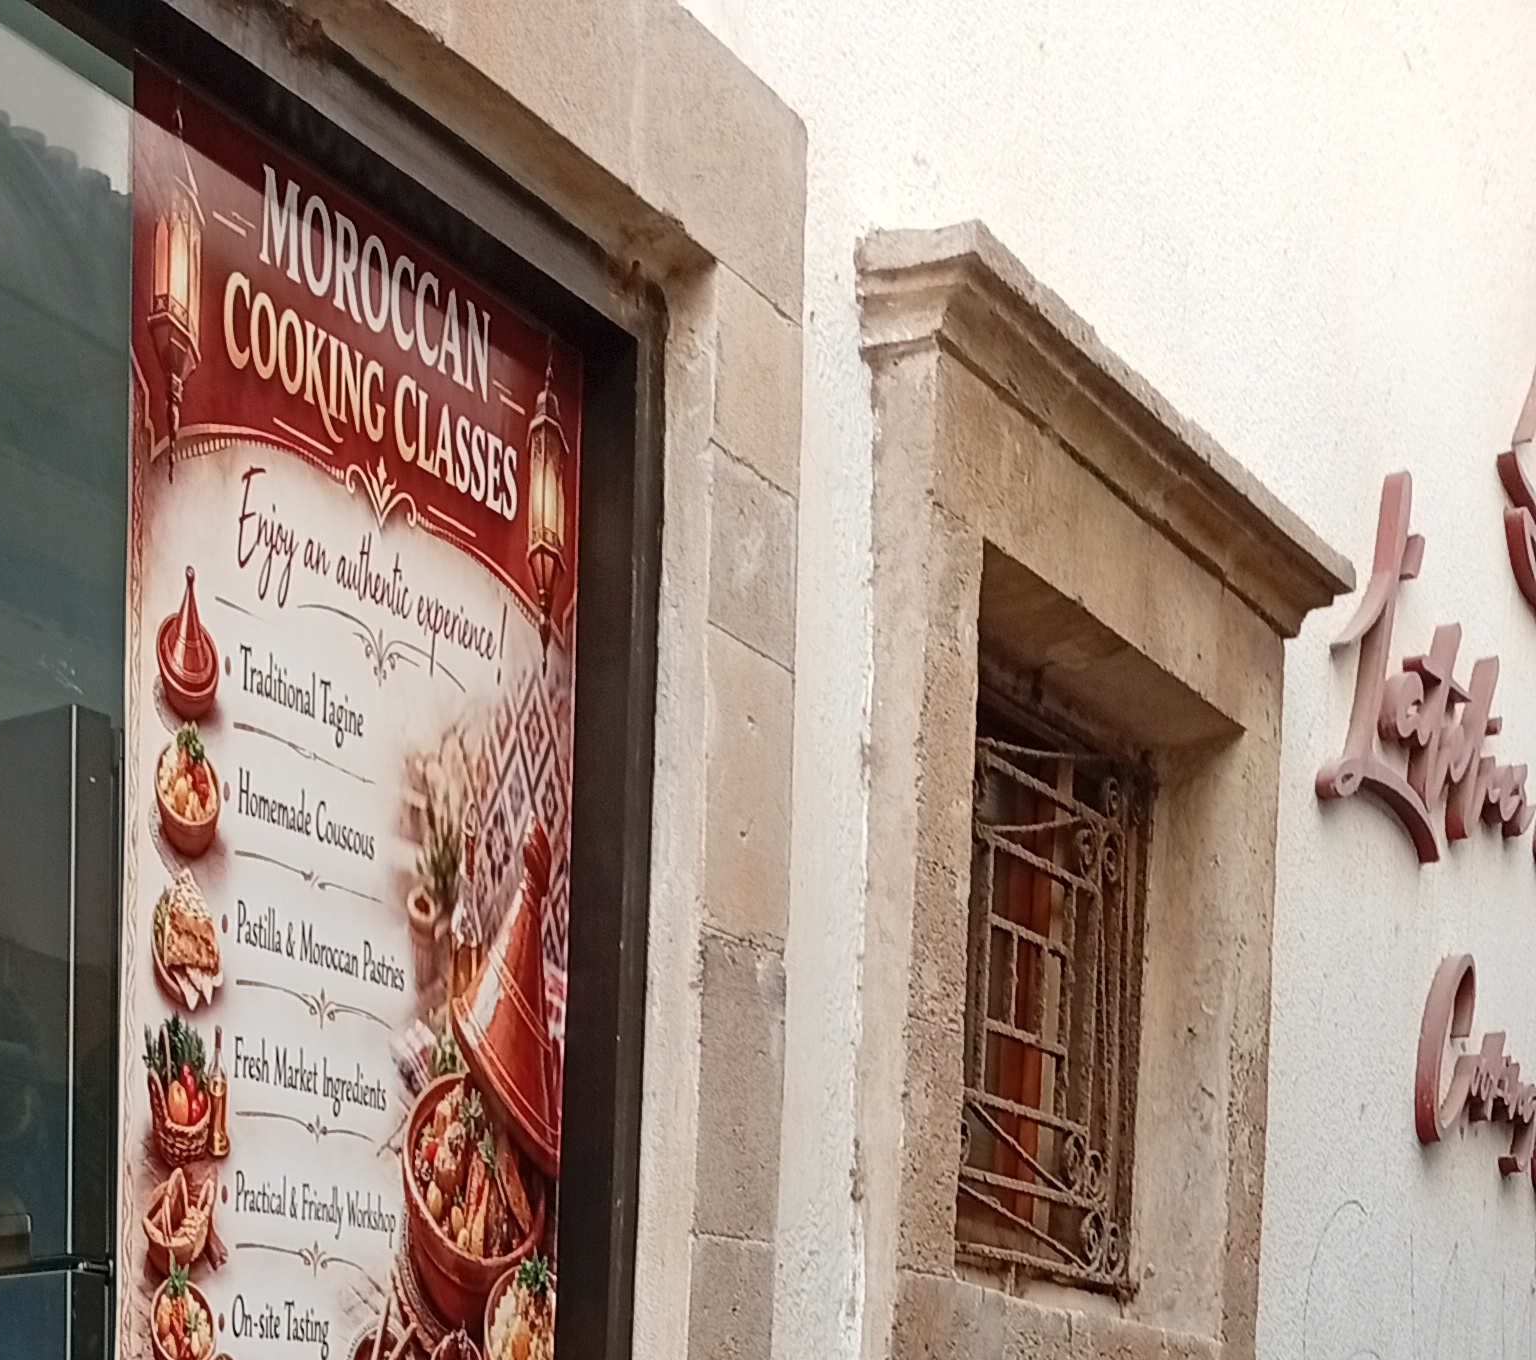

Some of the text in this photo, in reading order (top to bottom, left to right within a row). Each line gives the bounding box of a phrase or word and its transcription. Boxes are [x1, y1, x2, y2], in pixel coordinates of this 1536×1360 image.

[259, 163, 491, 404] MOROCCAN
[223, 271, 518, 522] COOKING CLASSES
[236, 466, 508, 686] Enjoy an authentic experience!
[238, 643, 364, 749] Traditional Tagine
[237, 767, 375, 861] Homemade Couscous
[236, 899, 406, 993] Pastilla & Moroccan Pastries
[233, 1035, 387, 1118] Fresh Market Ingredients
[234, 1170, 397, 1249] Practical & Friendly Workshop
[232, 1294, 330, 1360] On-site Tasting
